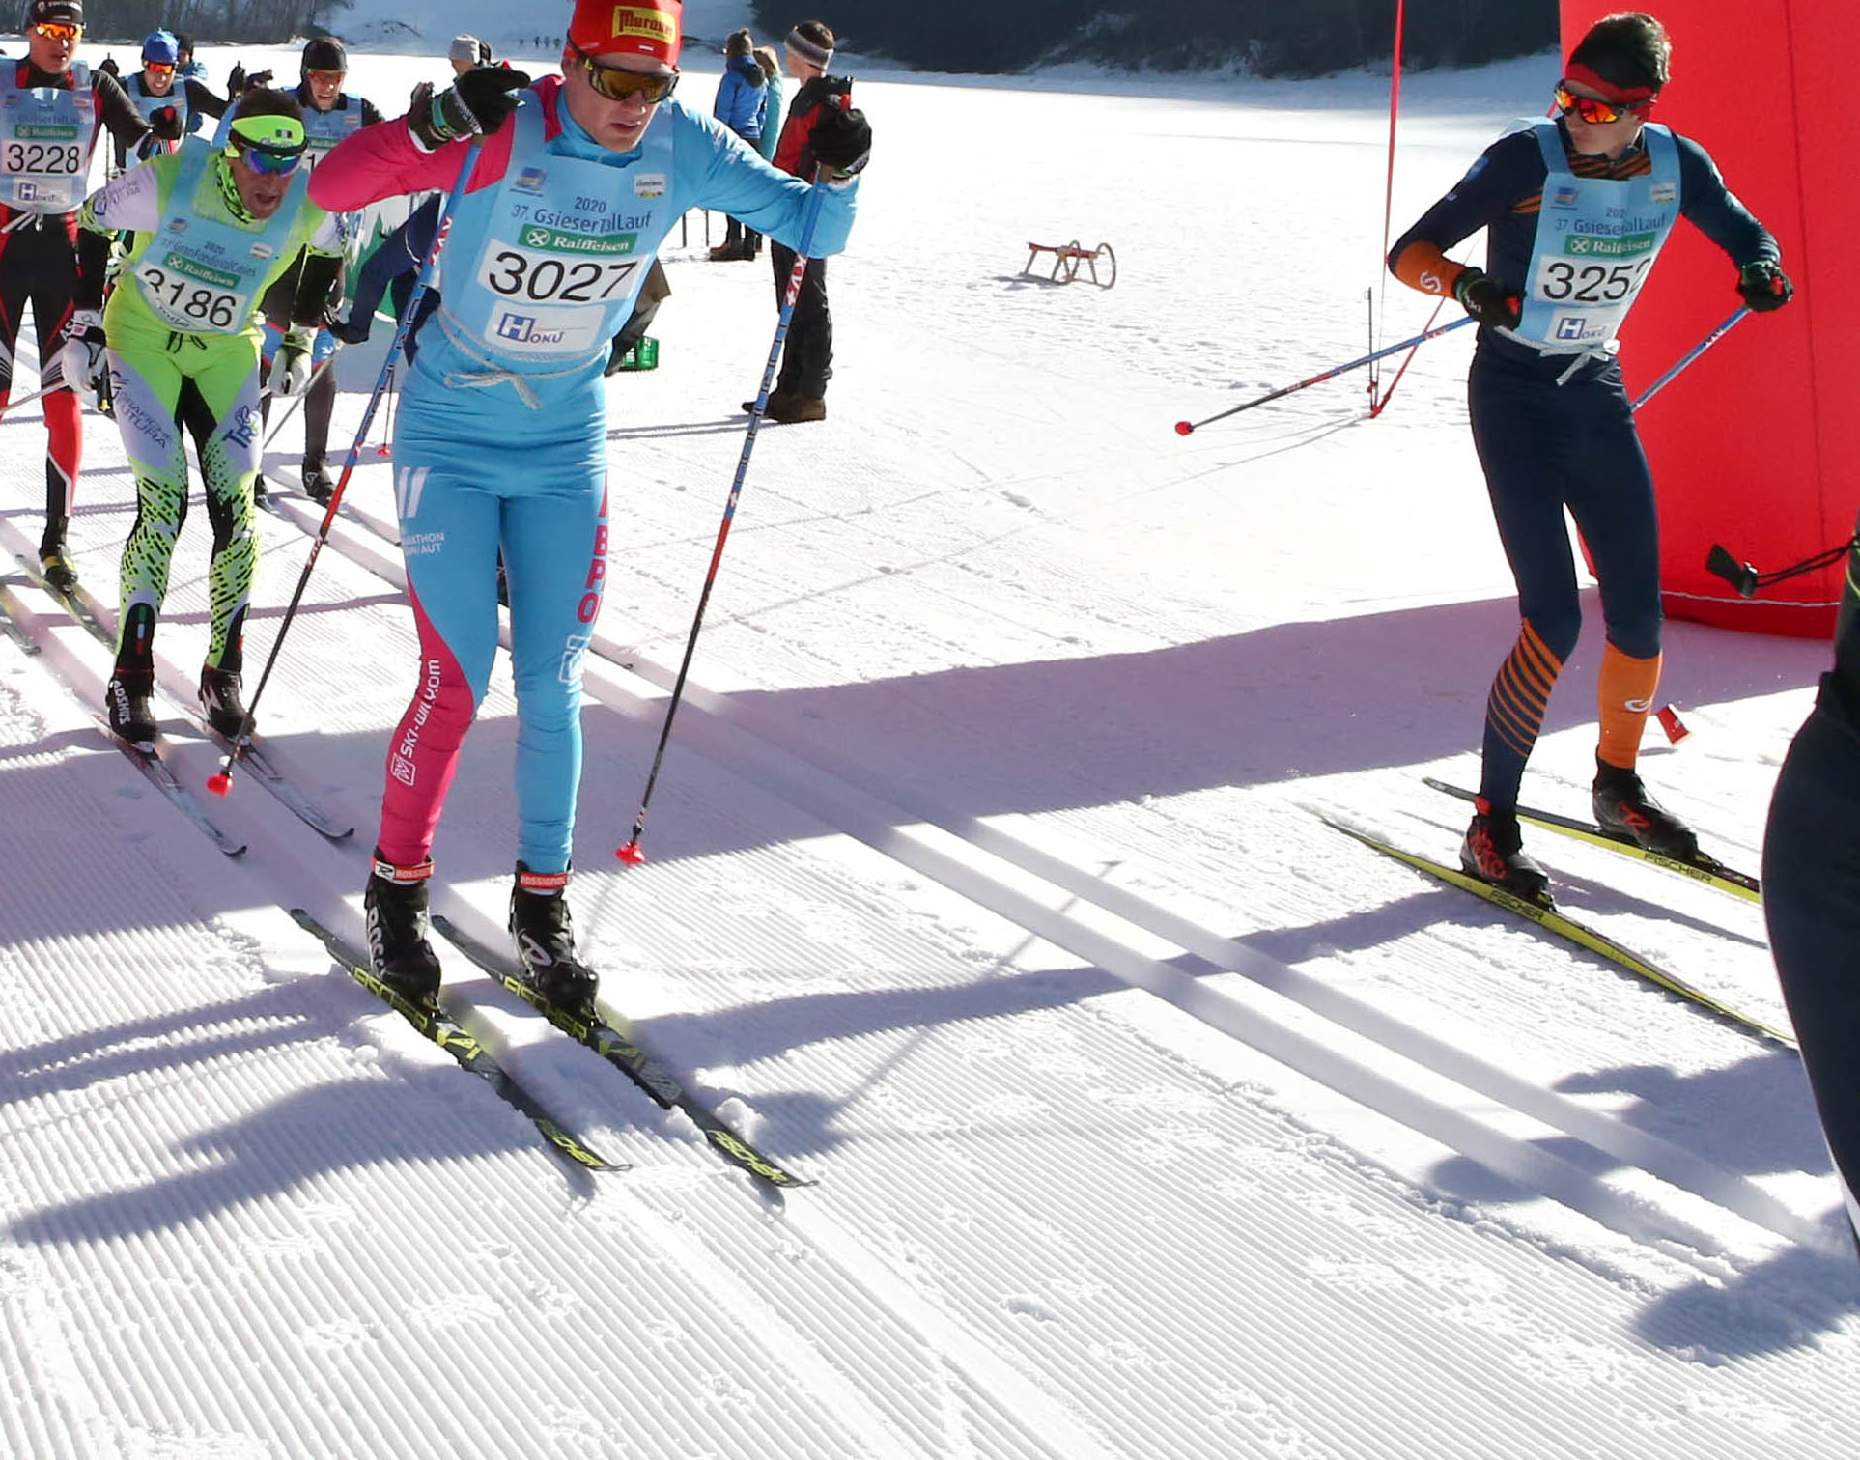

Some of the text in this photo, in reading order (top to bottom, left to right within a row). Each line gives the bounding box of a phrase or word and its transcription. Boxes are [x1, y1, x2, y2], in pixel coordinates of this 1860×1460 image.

[7, 144, 79, 174] 3228
[574, 196, 607, 213] 2020
[553, 236, 629, 251] Raiffeisen
[490, 251, 638, 302] 3027
[1644, 852, 1713, 885] FISCHER
[1490, 890, 1544, 922] FISCHER
